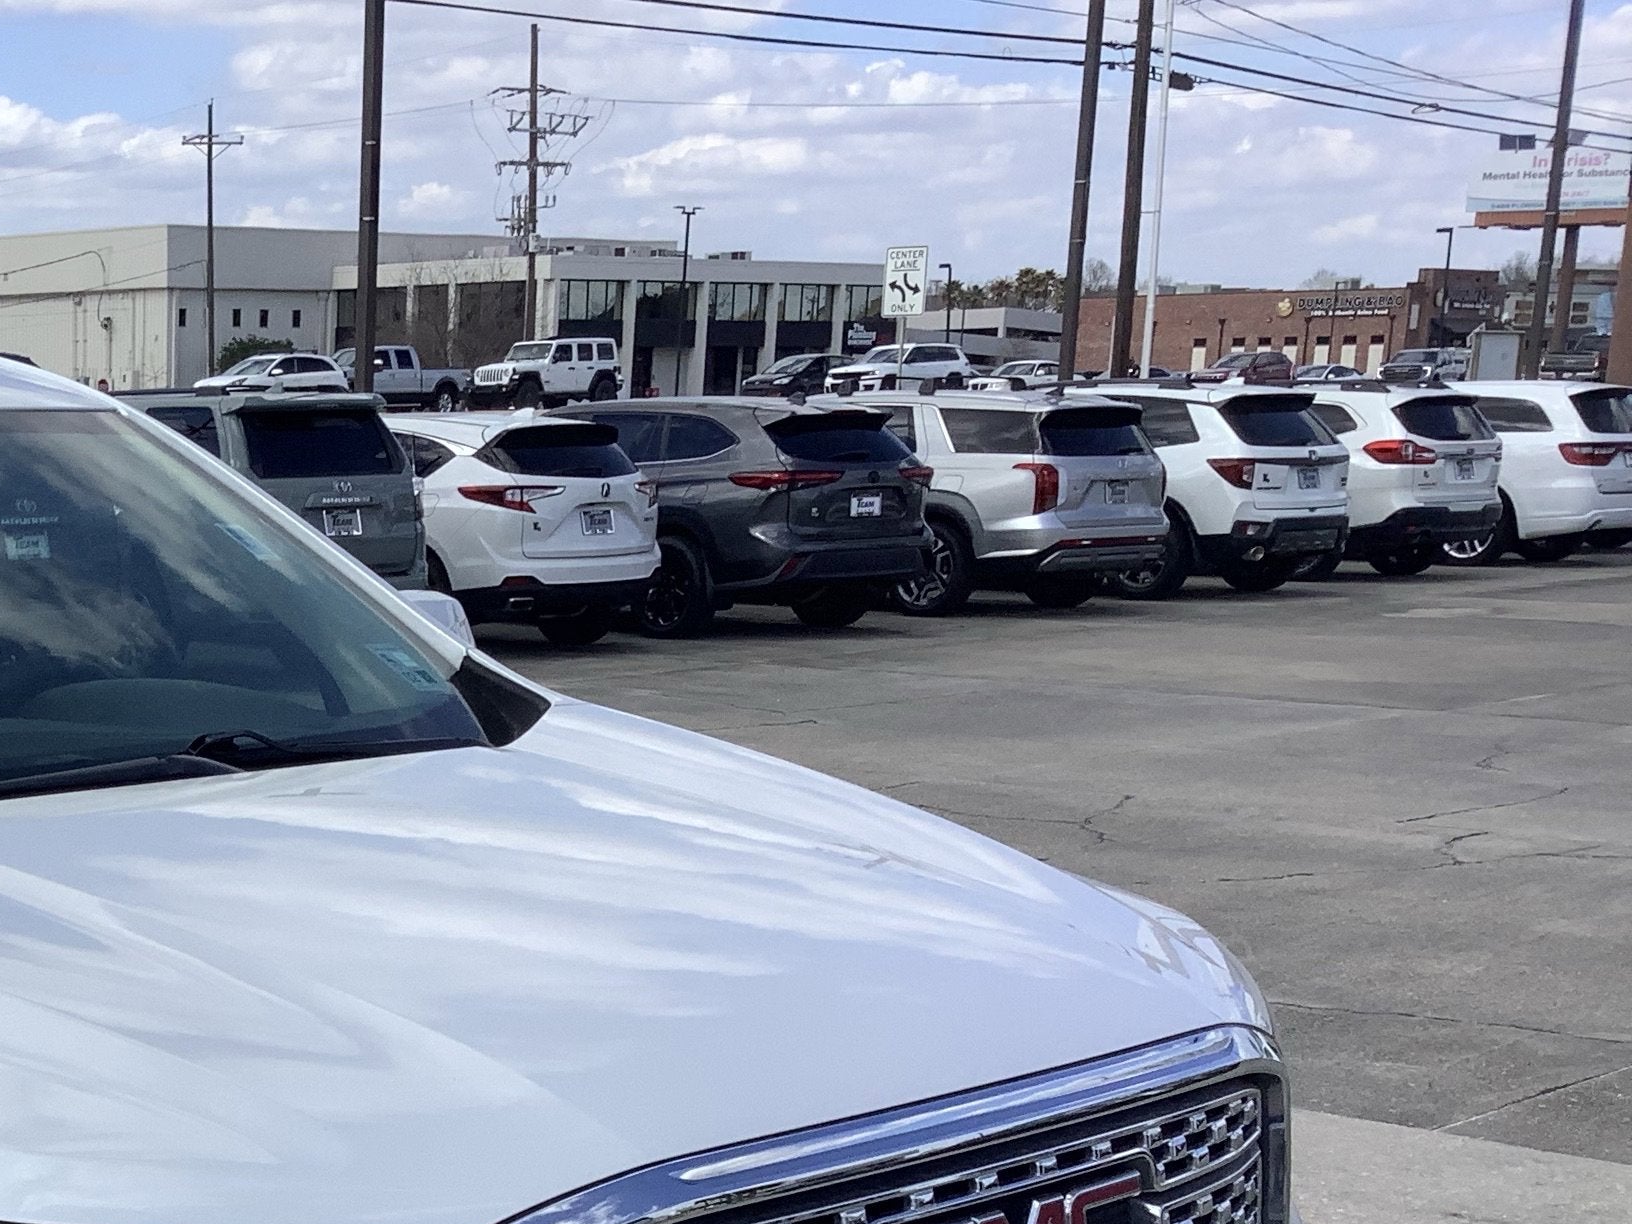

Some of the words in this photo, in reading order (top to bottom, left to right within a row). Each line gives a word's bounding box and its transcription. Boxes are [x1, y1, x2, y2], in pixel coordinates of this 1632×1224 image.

[1533, 155, 1548, 168] In
[1566, 153, 1611, 168] risis?
[1482, 171, 1520, 181] Mental
[1577, 168, 1630, 177] Substanc
[890, 250, 924, 260] CENTER
[894, 260, 919, 269] LANE
[1298, 297, 1361, 308] DUMPING
[1378, 295, 1404, 306] BAO
[891, 304, 915, 313] ONLY
